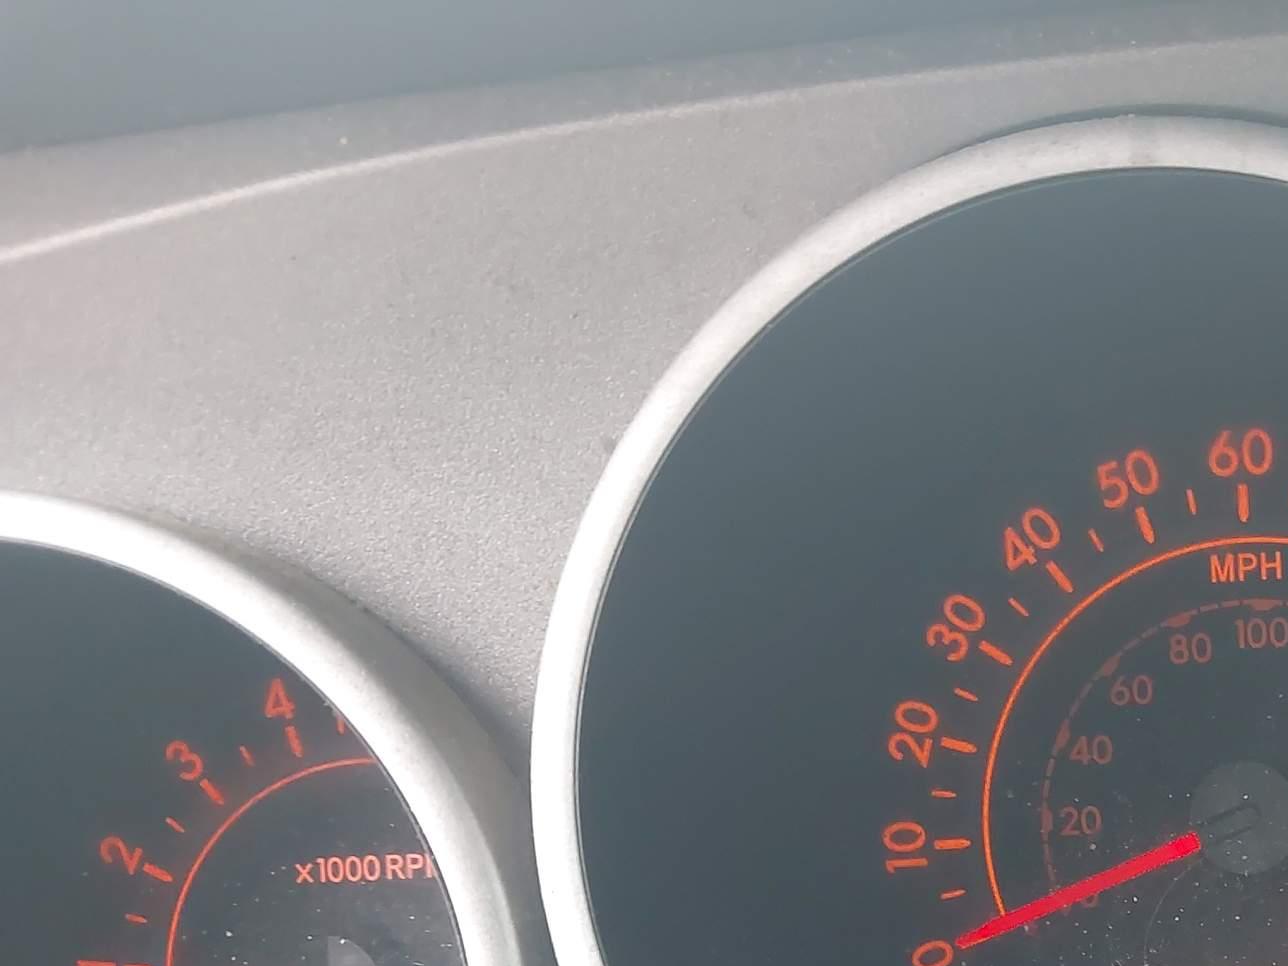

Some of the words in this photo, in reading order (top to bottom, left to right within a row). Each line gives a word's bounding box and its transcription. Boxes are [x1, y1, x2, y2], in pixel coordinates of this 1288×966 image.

[1209, 428, 1272, 478] 60
[1096, 449, 1161, 511] 50
[1001, 506, 1062, 574] 40
[1209, 551, 1283, 585] MPH
[924, 594, 986, 664] 30
[1169, 632, 1213, 666] 80
[265, 678, 294, 719] 4
[1110, 674, 1153, 707] 60
[887, 700, 938, 768] 20
[1069, 735, 1113, 766] 40
[166, 740, 203, 781] 3
[1059, 805, 1102, 837] 20
[100, 837, 143, 875] 2
[883, 821, 927, 874] 10
[296, 855, 379, 883] x1000
